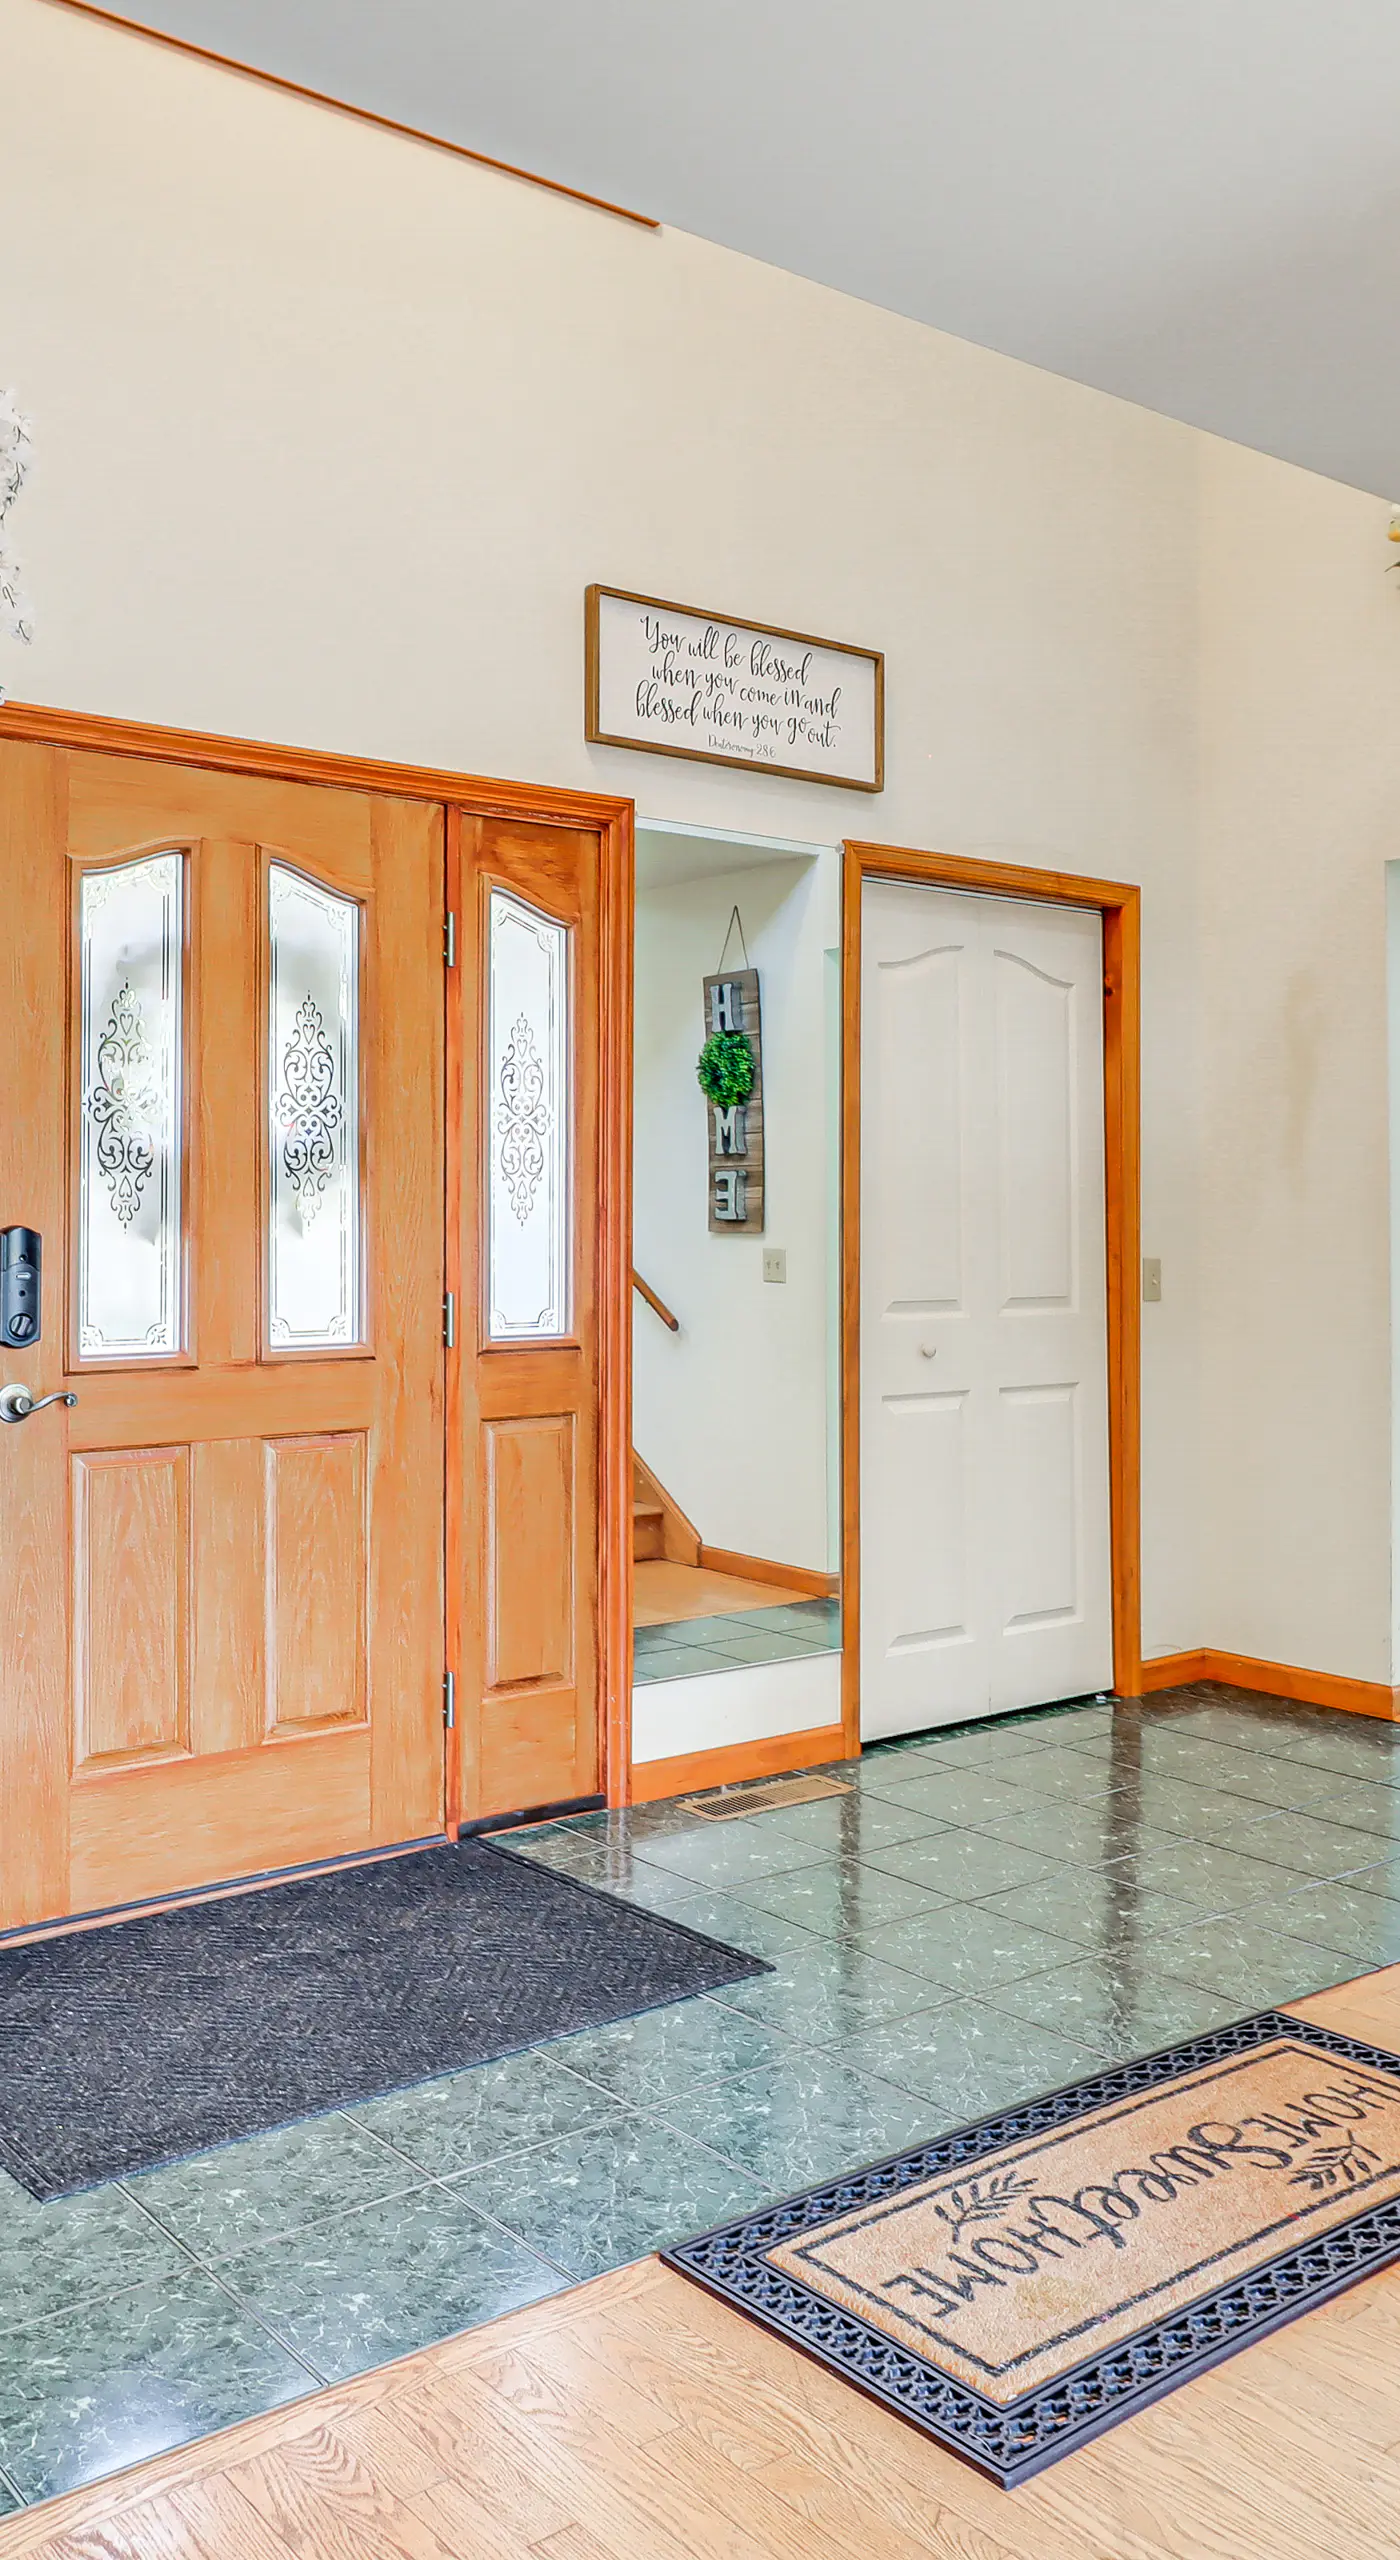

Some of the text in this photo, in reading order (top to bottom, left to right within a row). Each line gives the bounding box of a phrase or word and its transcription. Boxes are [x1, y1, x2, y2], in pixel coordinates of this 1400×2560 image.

[640, 615, 813, 685] You will be blessed
[636, 680, 841, 748] blessed when you go out.
[652, 651, 841, 719] when you come in and
[881, 2079, 1400, 2318] HOME Sweet HOME
